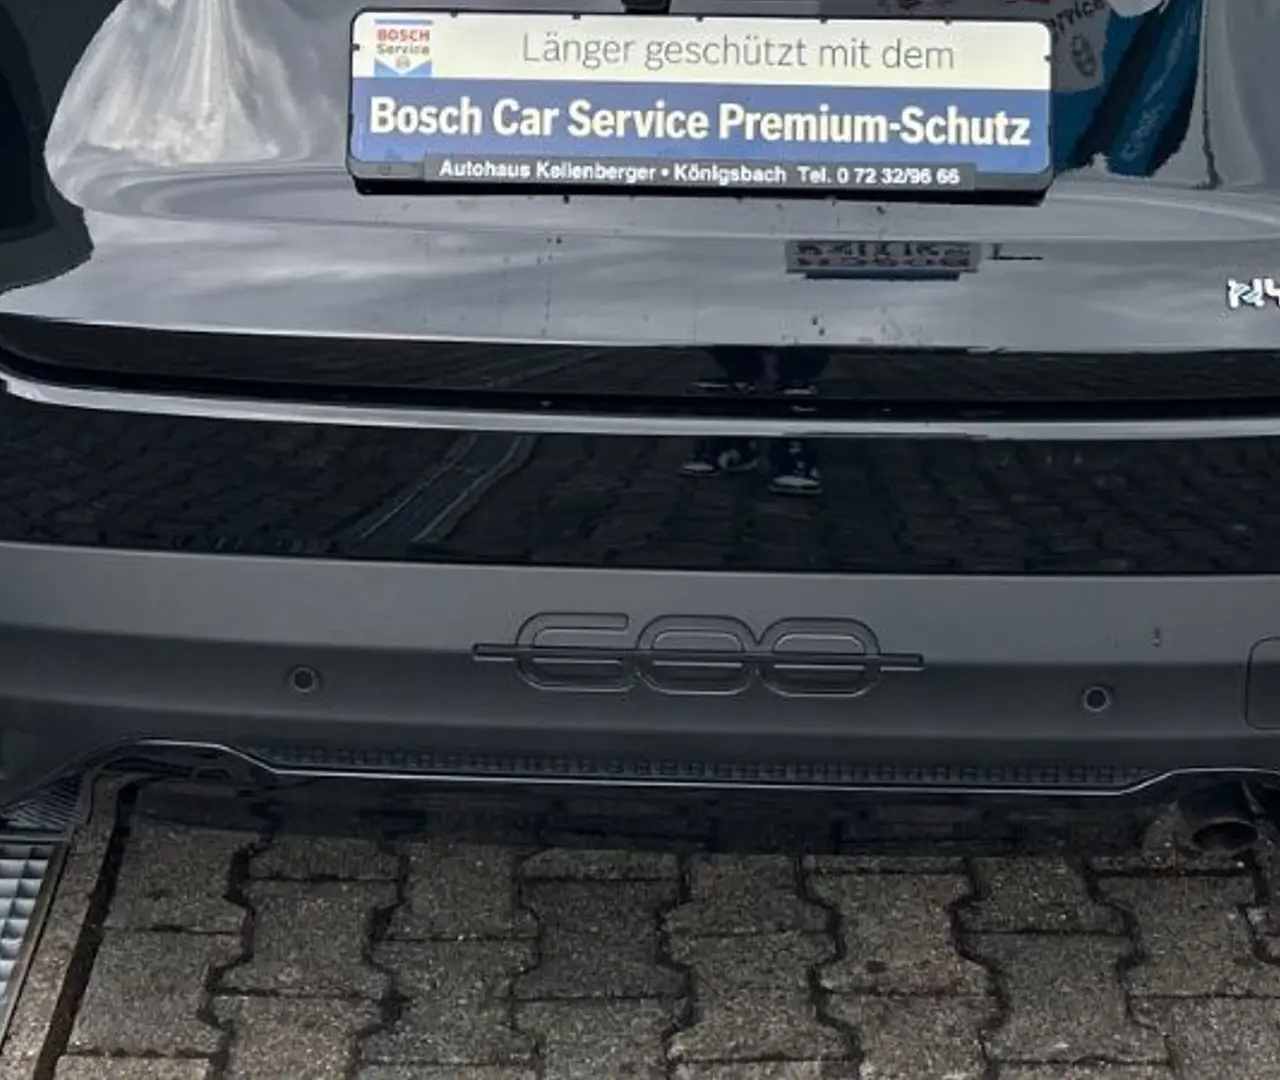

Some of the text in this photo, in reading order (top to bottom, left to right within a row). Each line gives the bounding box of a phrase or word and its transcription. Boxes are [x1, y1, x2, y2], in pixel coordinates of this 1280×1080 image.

[377, 28, 431, 41] BOSCH
[376, 43, 430, 55] Service
[523, 31, 955, 71] Länger geschützt mit dem
[370, 96, 1031, 147] Bosch Car Service Premium-Schutz
[439, 159, 531, 178] Autohaus
[536, 160, 656, 183] Kellenberger
[673, 163, 787, 186] Königsbach
[797, 166, 832, 184] Tel.
